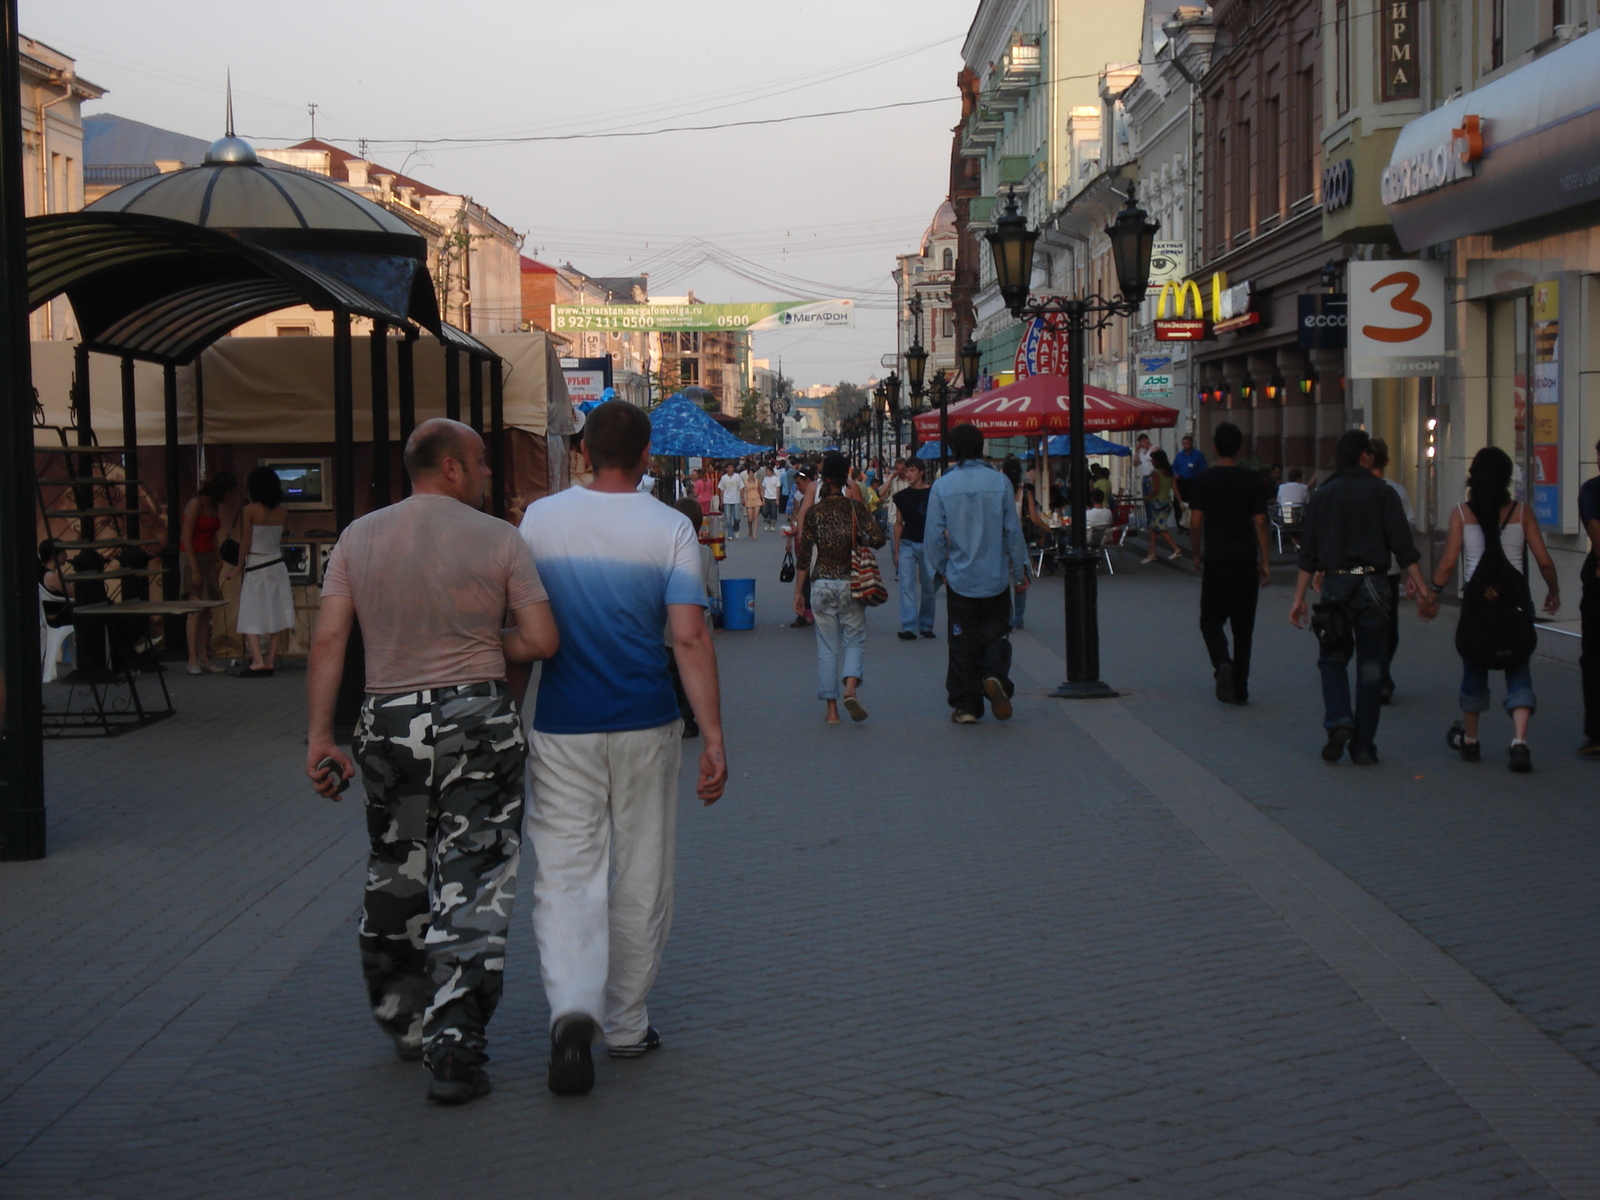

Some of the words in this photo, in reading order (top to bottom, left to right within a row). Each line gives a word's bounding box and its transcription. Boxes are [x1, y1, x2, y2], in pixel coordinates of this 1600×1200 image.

[557, 305, 703, 318] www.tatarstan.megafonvolga.ru
[557, 316, 566, 327] 8
[569, 316, 591, 327] 927
[596, 316, 619, 327] 111
[622, 316, 654, 327] 0500
[717, 315, 749, 326] 0500
[1304, 314, 1349, 328] ecco
